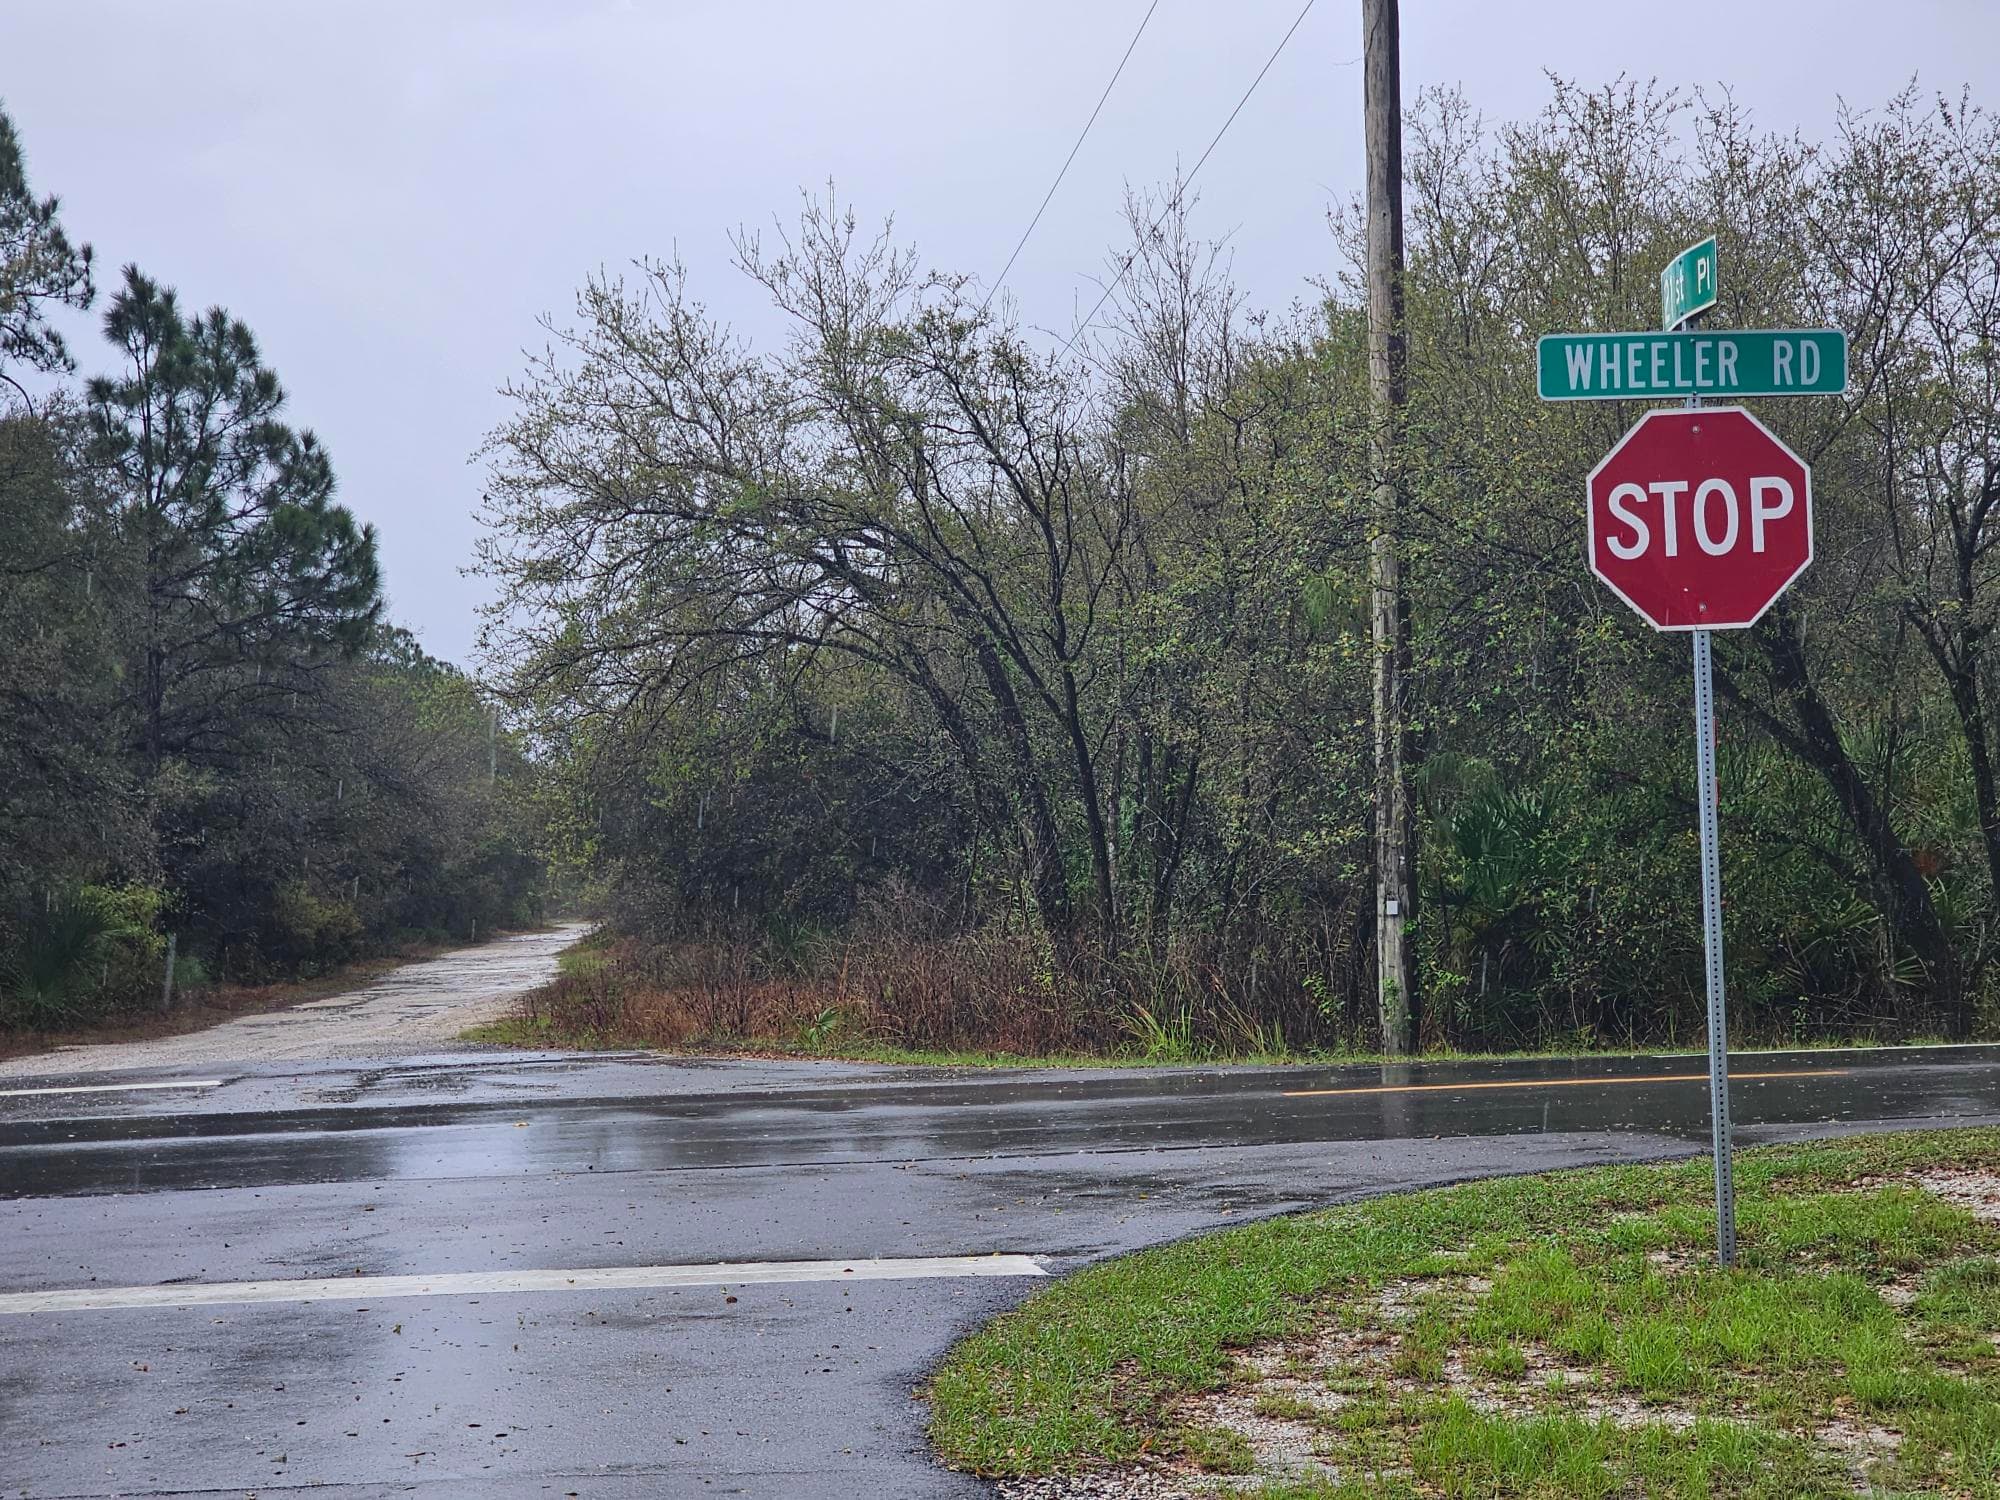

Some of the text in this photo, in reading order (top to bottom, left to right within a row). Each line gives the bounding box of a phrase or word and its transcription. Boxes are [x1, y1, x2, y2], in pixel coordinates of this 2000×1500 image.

[1697, 255, 1711, 295] Pl
[1564, 339, 1821, 391] WHEELER RD
[1606, 476, 1794, 560] STOP
